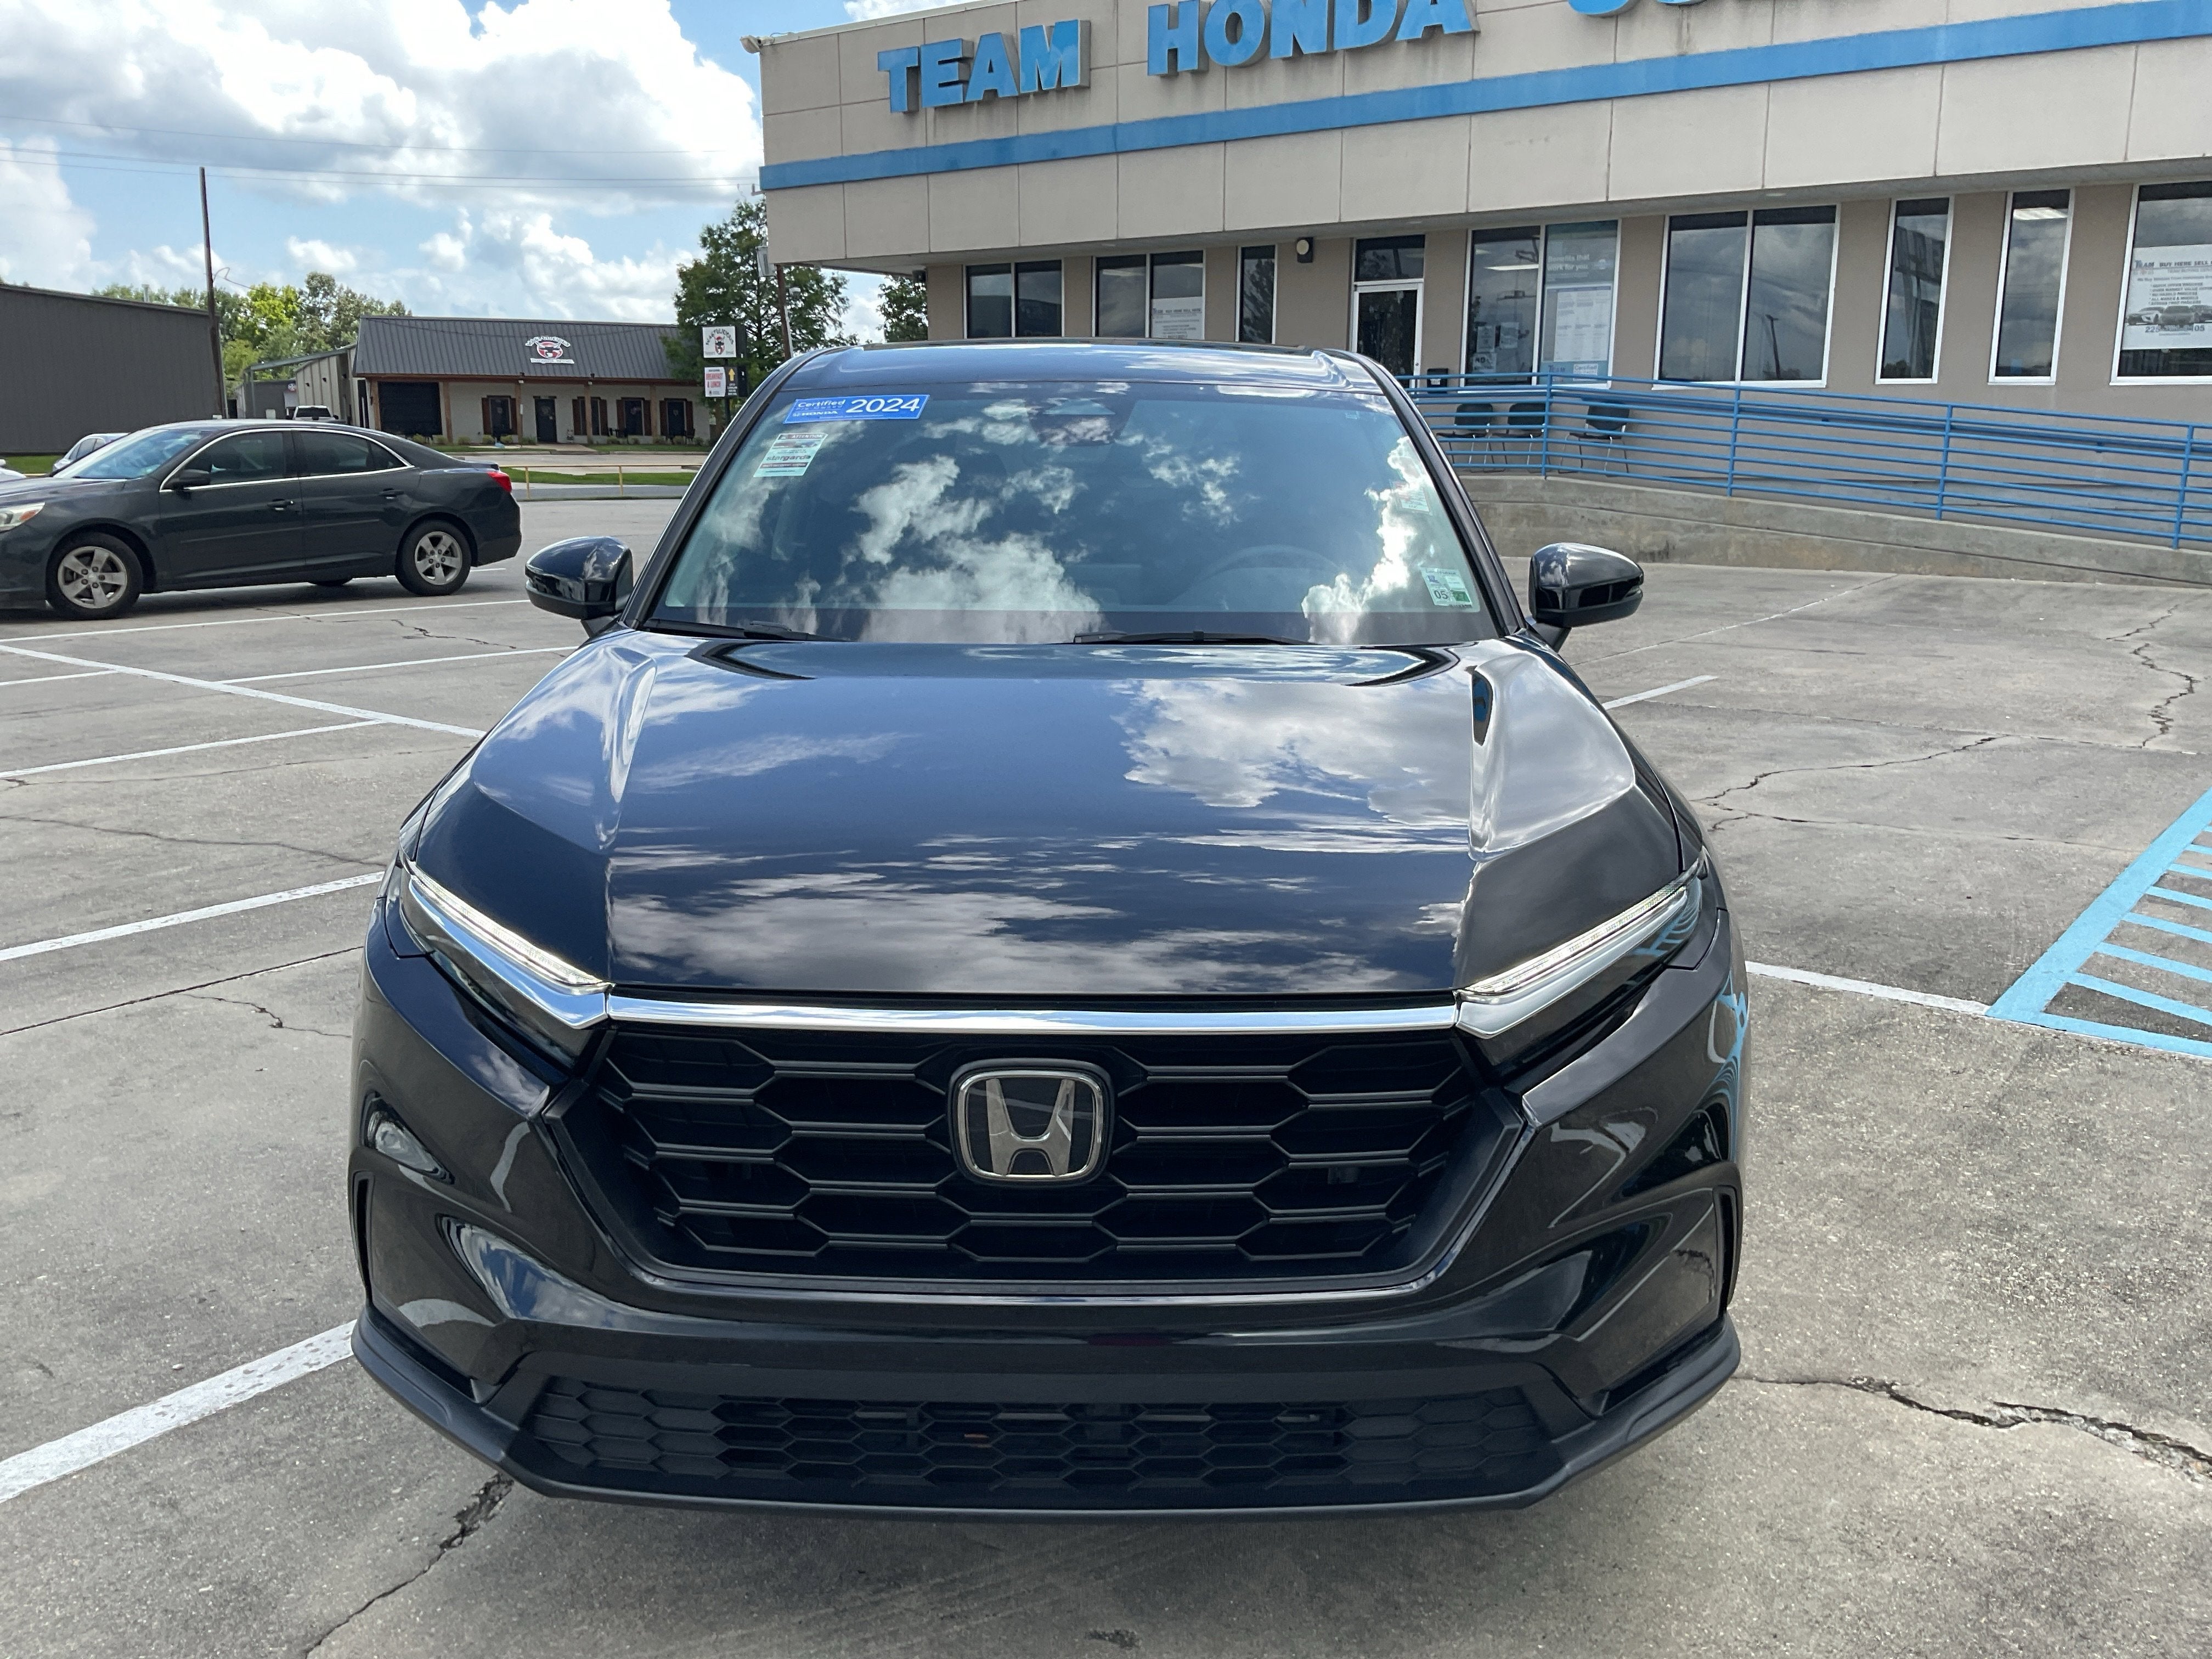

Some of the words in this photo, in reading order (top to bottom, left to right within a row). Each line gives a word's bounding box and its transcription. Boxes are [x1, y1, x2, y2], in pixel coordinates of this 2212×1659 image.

[878, 19, 1088, 113] TEAM
[798, 399, 846, 408] Certified
[845, 398, 920, 413] 2024
[1434, 590, 1448, 599] 05
